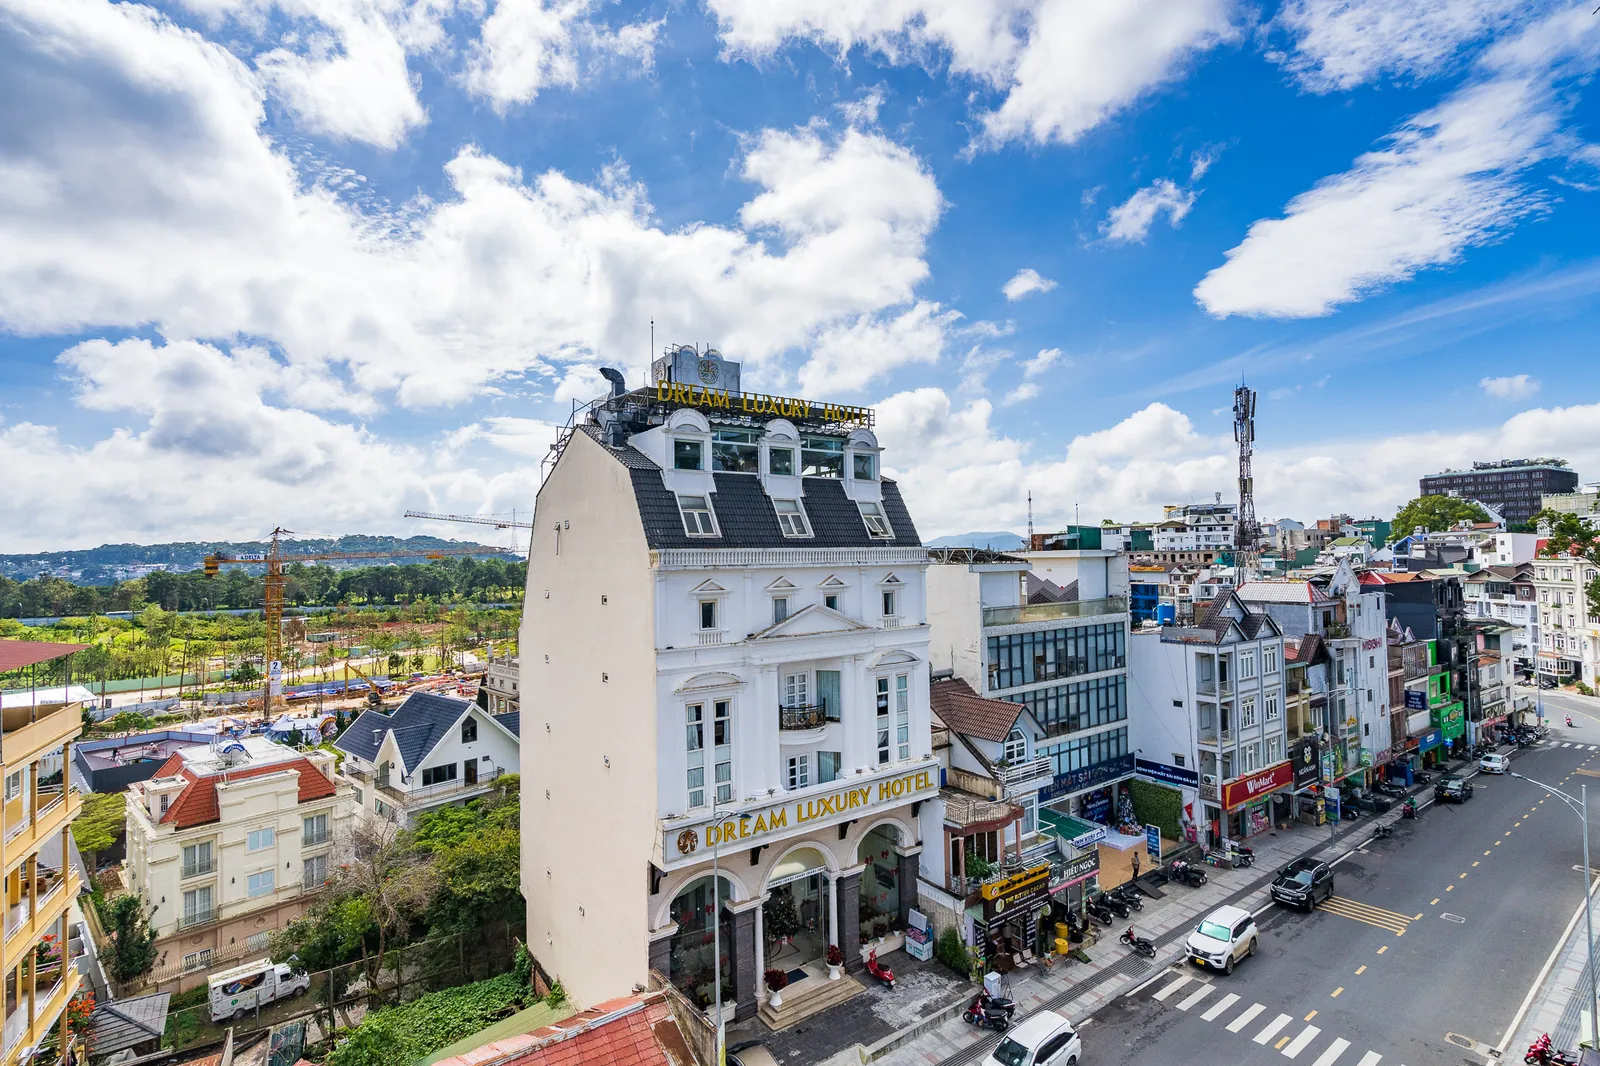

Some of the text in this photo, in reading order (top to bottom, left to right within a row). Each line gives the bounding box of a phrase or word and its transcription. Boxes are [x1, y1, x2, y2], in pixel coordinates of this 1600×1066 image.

[657, 379, 729, 409] DREAM
[742, 391, 811, 418] LUXURY
[706, 771, 934, 848] DREAM LUXURY HOTEL
